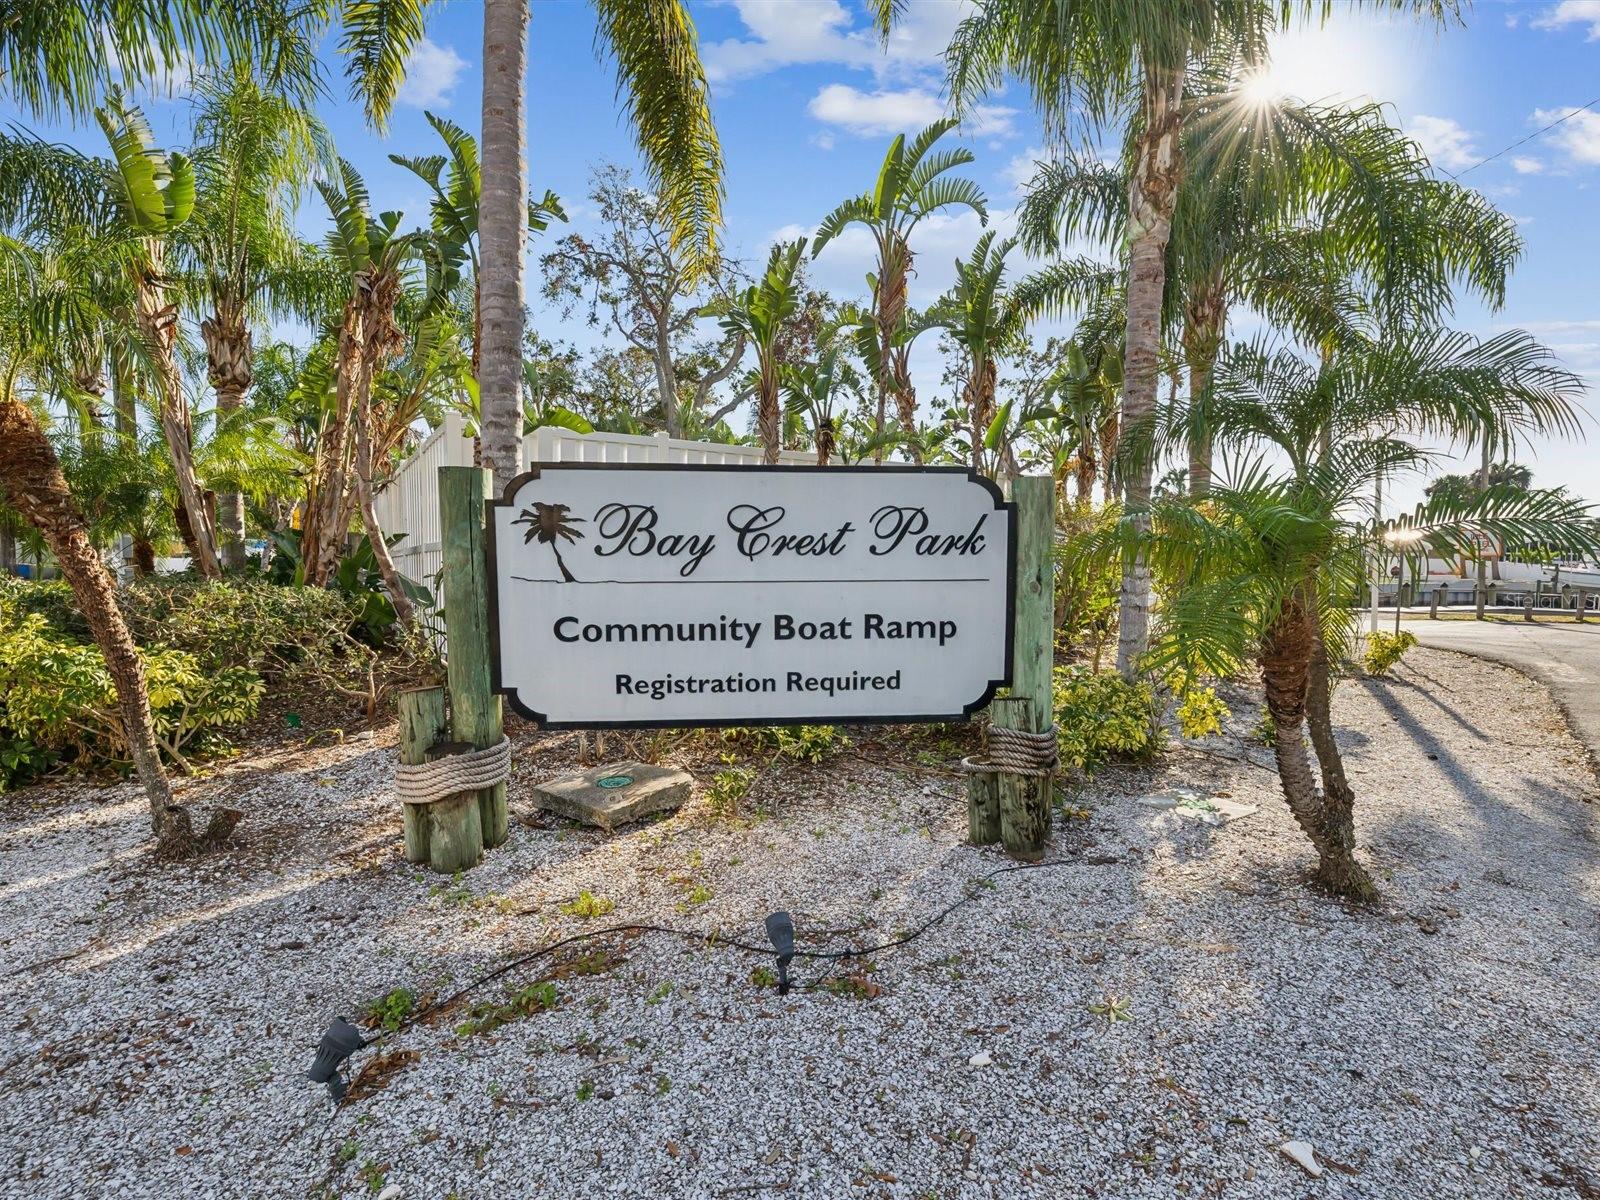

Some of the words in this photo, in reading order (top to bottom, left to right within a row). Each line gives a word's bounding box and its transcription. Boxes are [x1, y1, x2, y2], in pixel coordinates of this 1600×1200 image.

[593, 502, 716, 578] Bay
[726, 503, 857, 562] Crest
[868, 504, 989, 557] Park
[553, 614, 762, 649] Community
[774, 613, 852, 641] Boat
[864, 612, 957, 647] Ramp
[615, 672, 776, 701] Registration
[786, 669, 901, 698] Required
